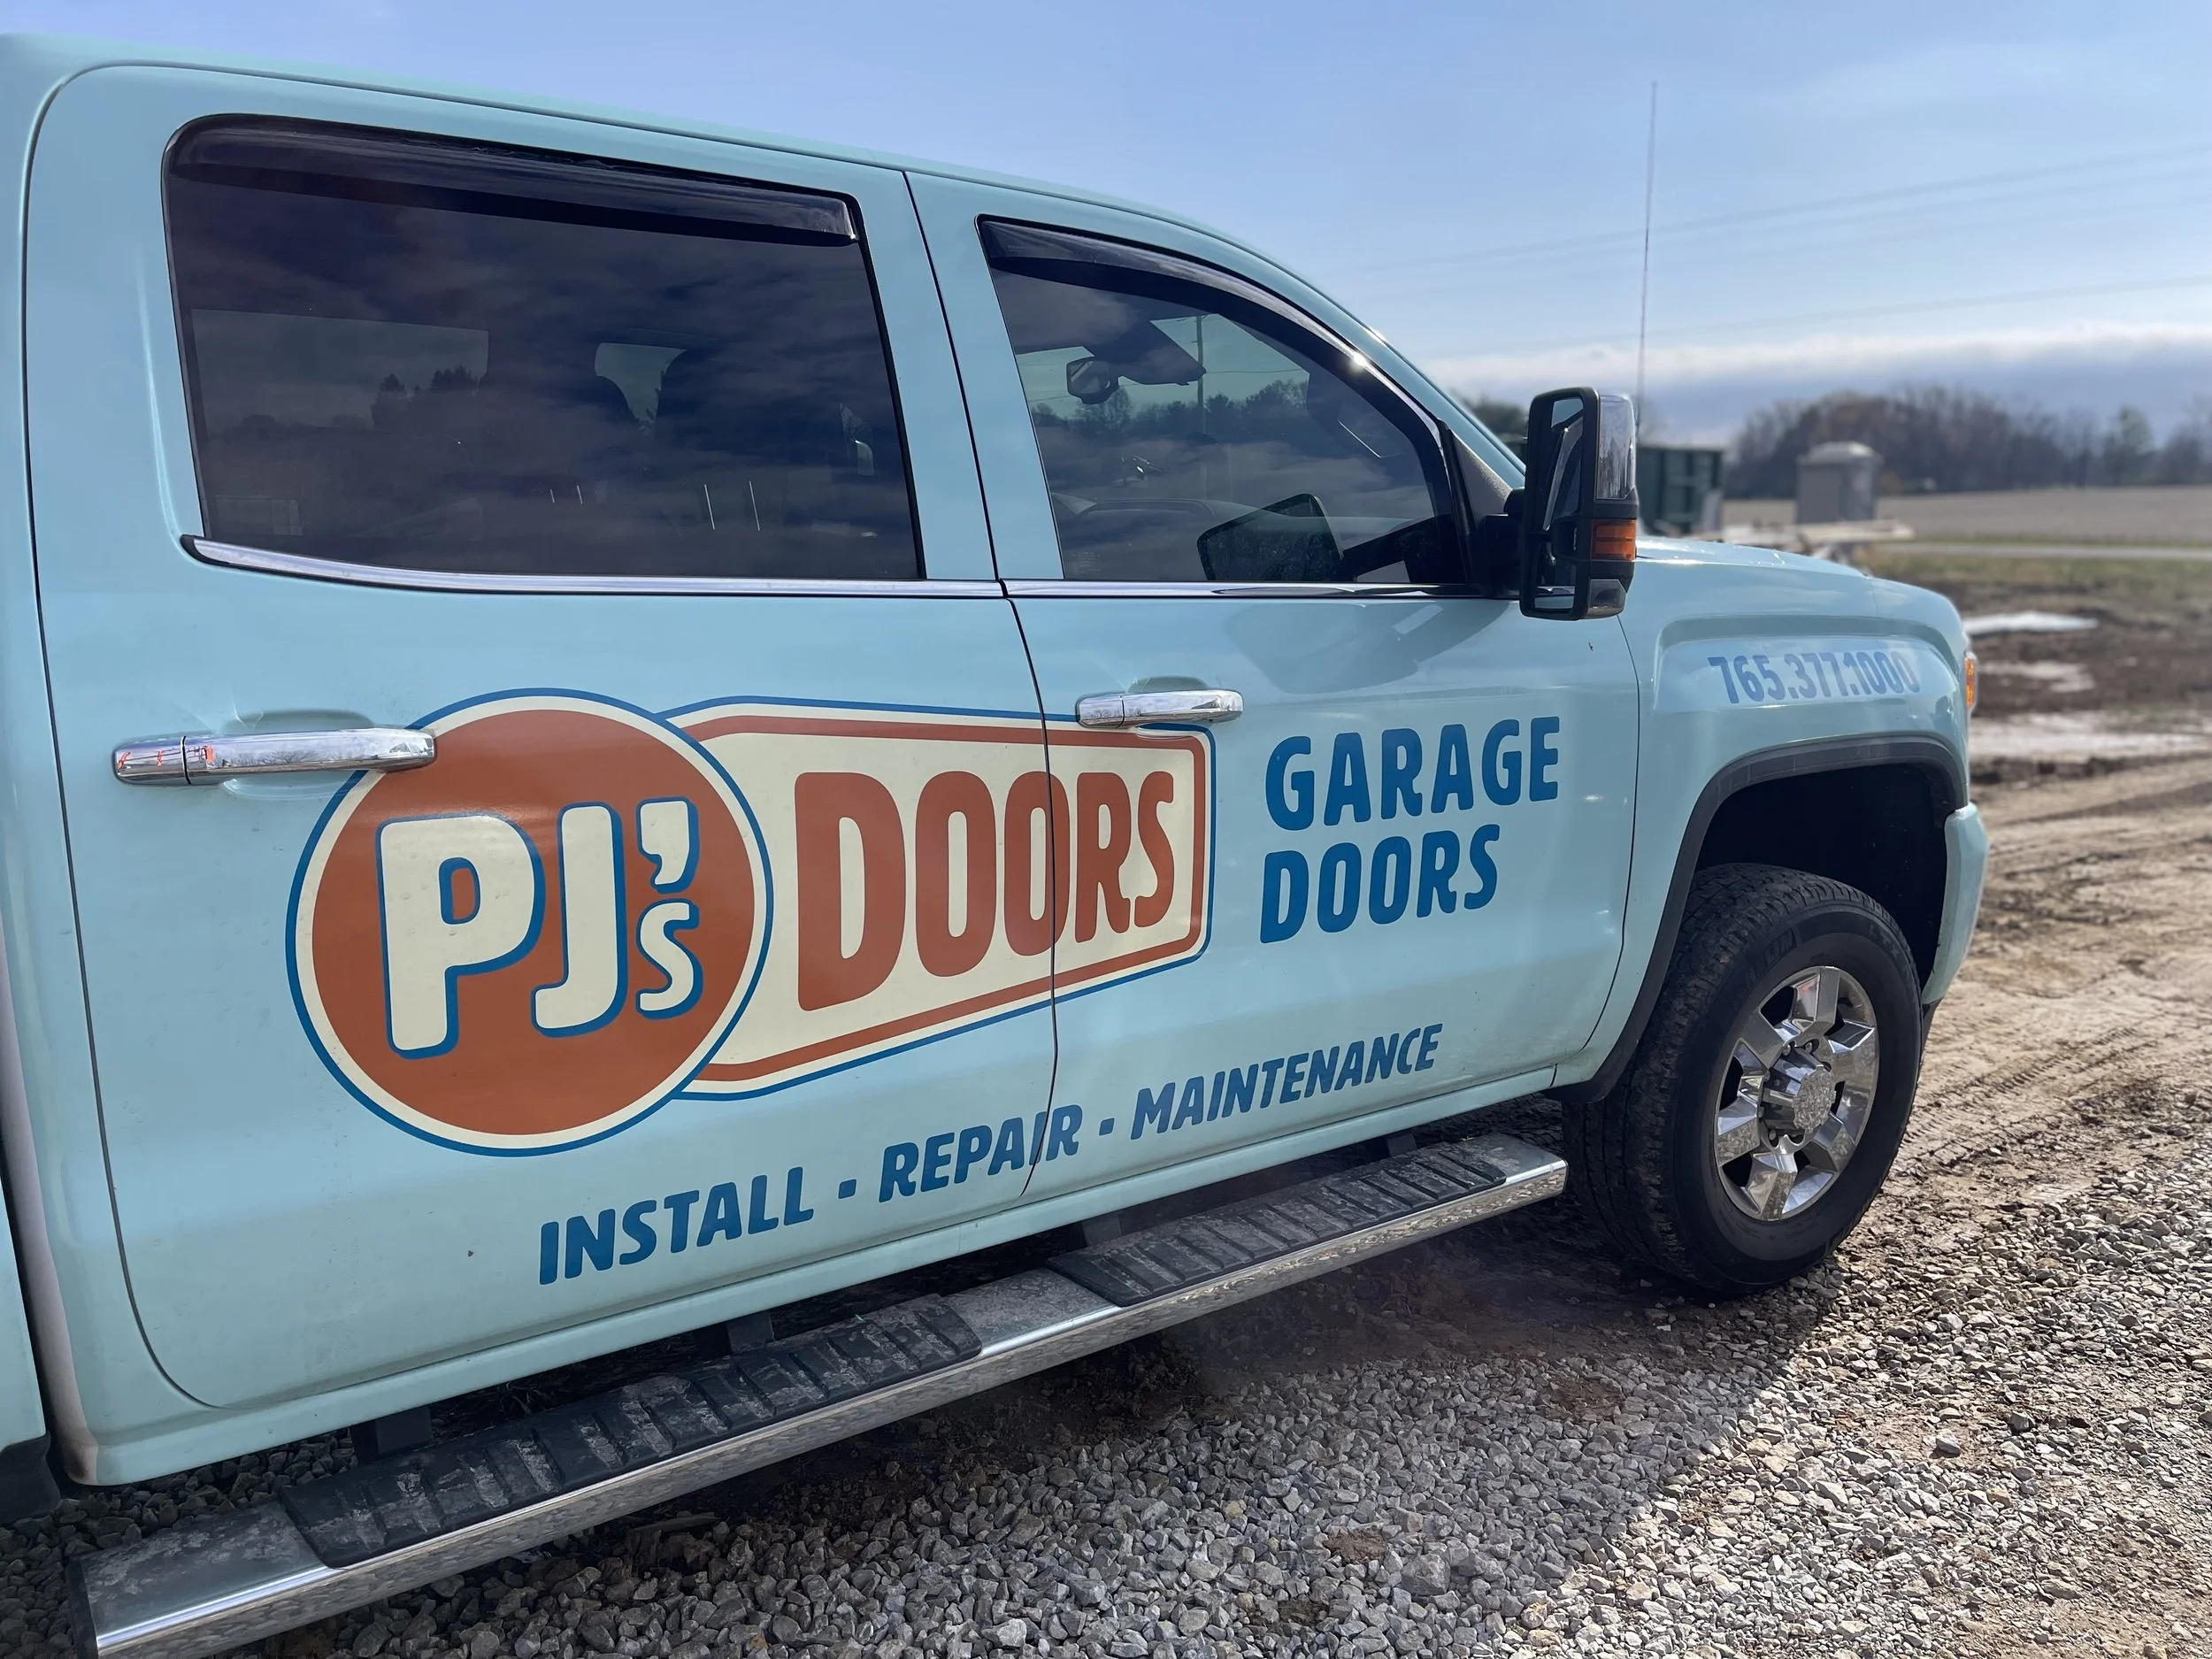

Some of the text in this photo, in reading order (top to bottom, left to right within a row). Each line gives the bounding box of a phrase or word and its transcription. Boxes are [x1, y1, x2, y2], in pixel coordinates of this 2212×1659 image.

[1707, 650, 1921, 703] 765.377.1000
[1265, 716, 1561, 831] GARAGE
[794, 770, 1175, 1011] DOORS
[1260, 824, 1501, 943] DOORS
[539, 1023, 1444, 1285] INSTALL REPAIR MAINTENANCE
